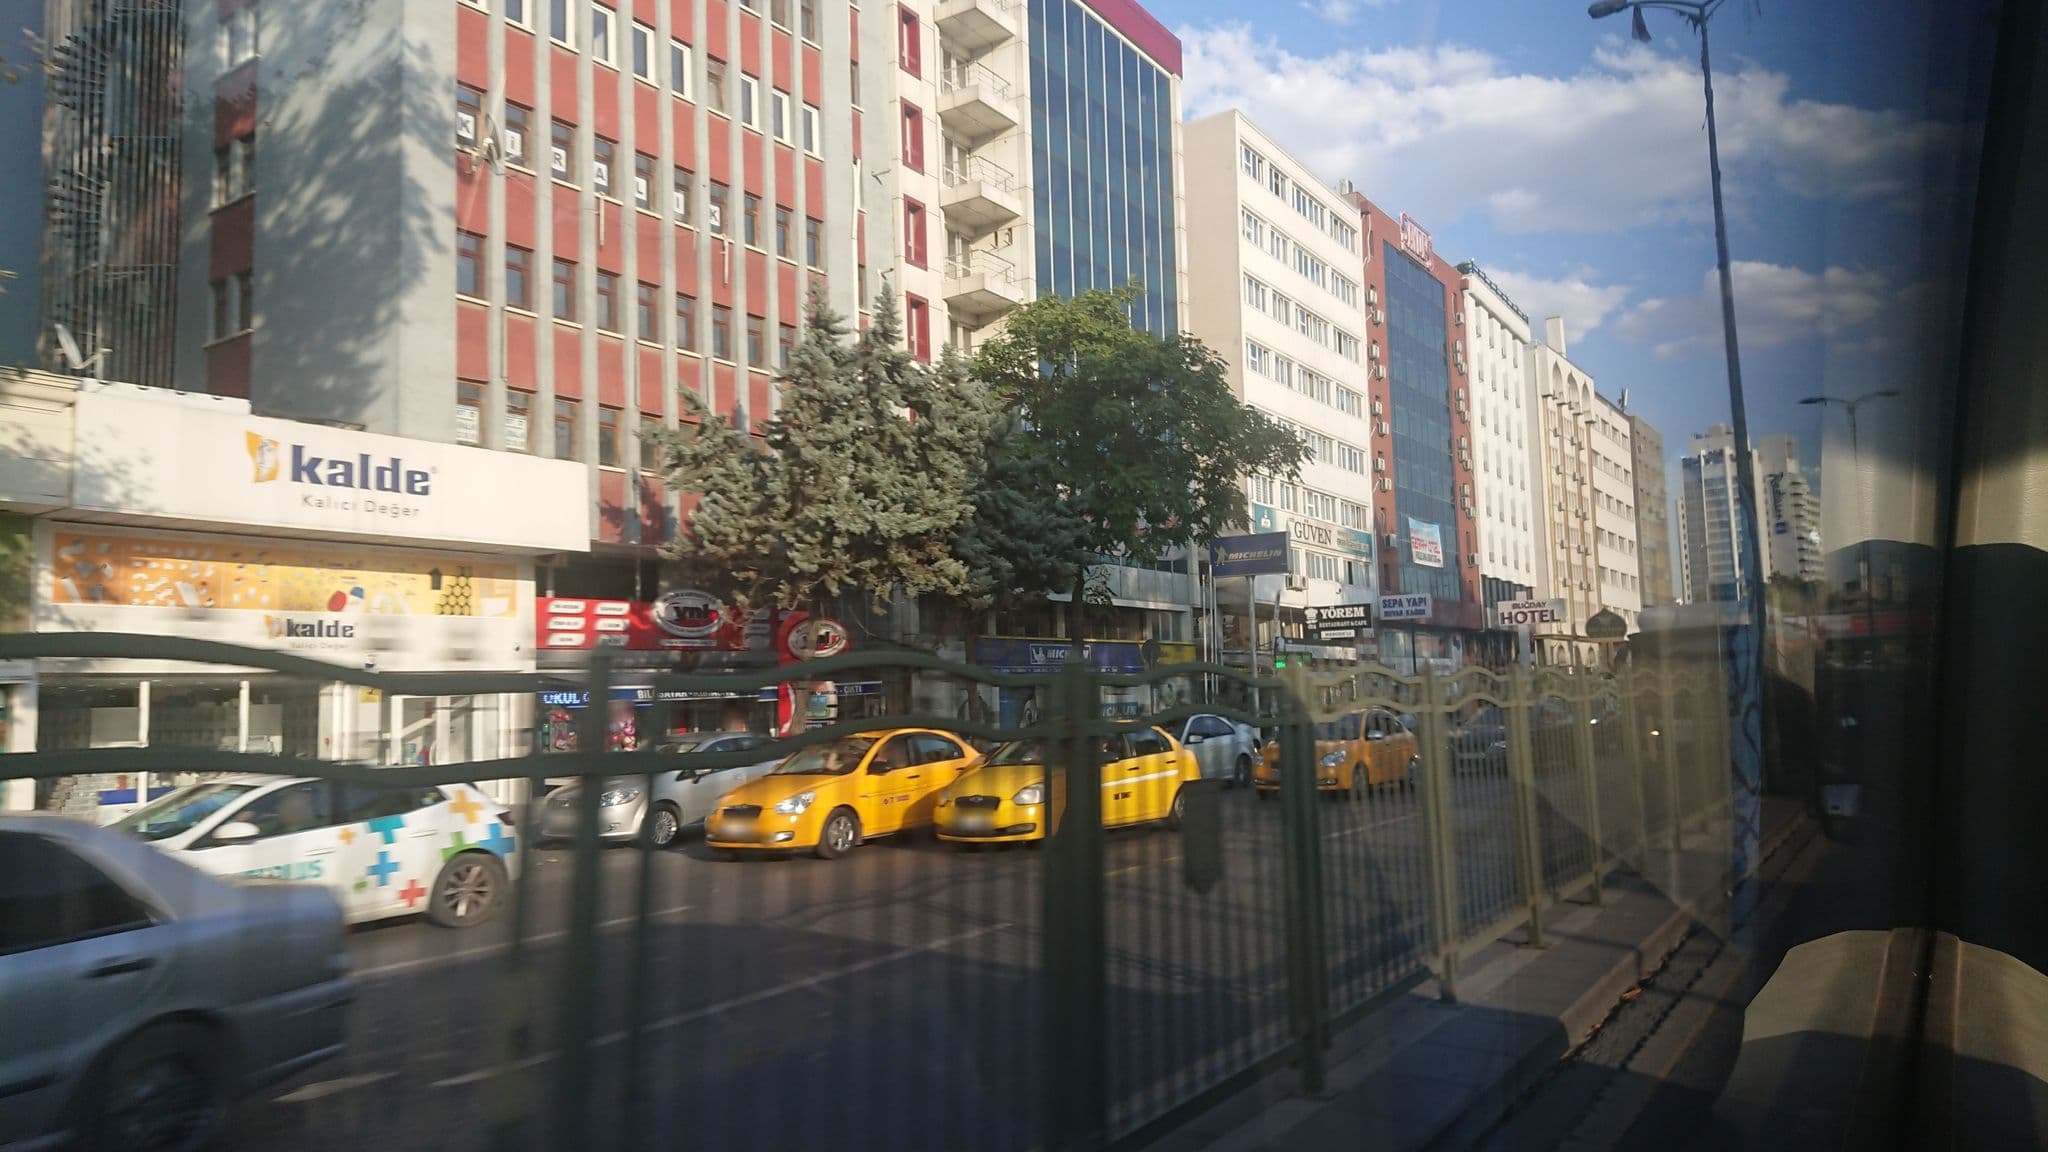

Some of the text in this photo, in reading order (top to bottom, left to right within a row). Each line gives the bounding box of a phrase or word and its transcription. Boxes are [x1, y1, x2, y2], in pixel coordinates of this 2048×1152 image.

[291, 445, 430, 496] kalde
[303, 494, 420, 518] Kalıcı Değer
[1294, 519, 1332, 545] GÜVEN
[1228, 550, 1282, 561] MICHELIN
[1320, 605, 1365, 619] YÖREM
[1383, 598, 1403, 609] SEPA
[1500, 609, 1560, 624] HOTEL
[286, 618, 354, 638] kalde
